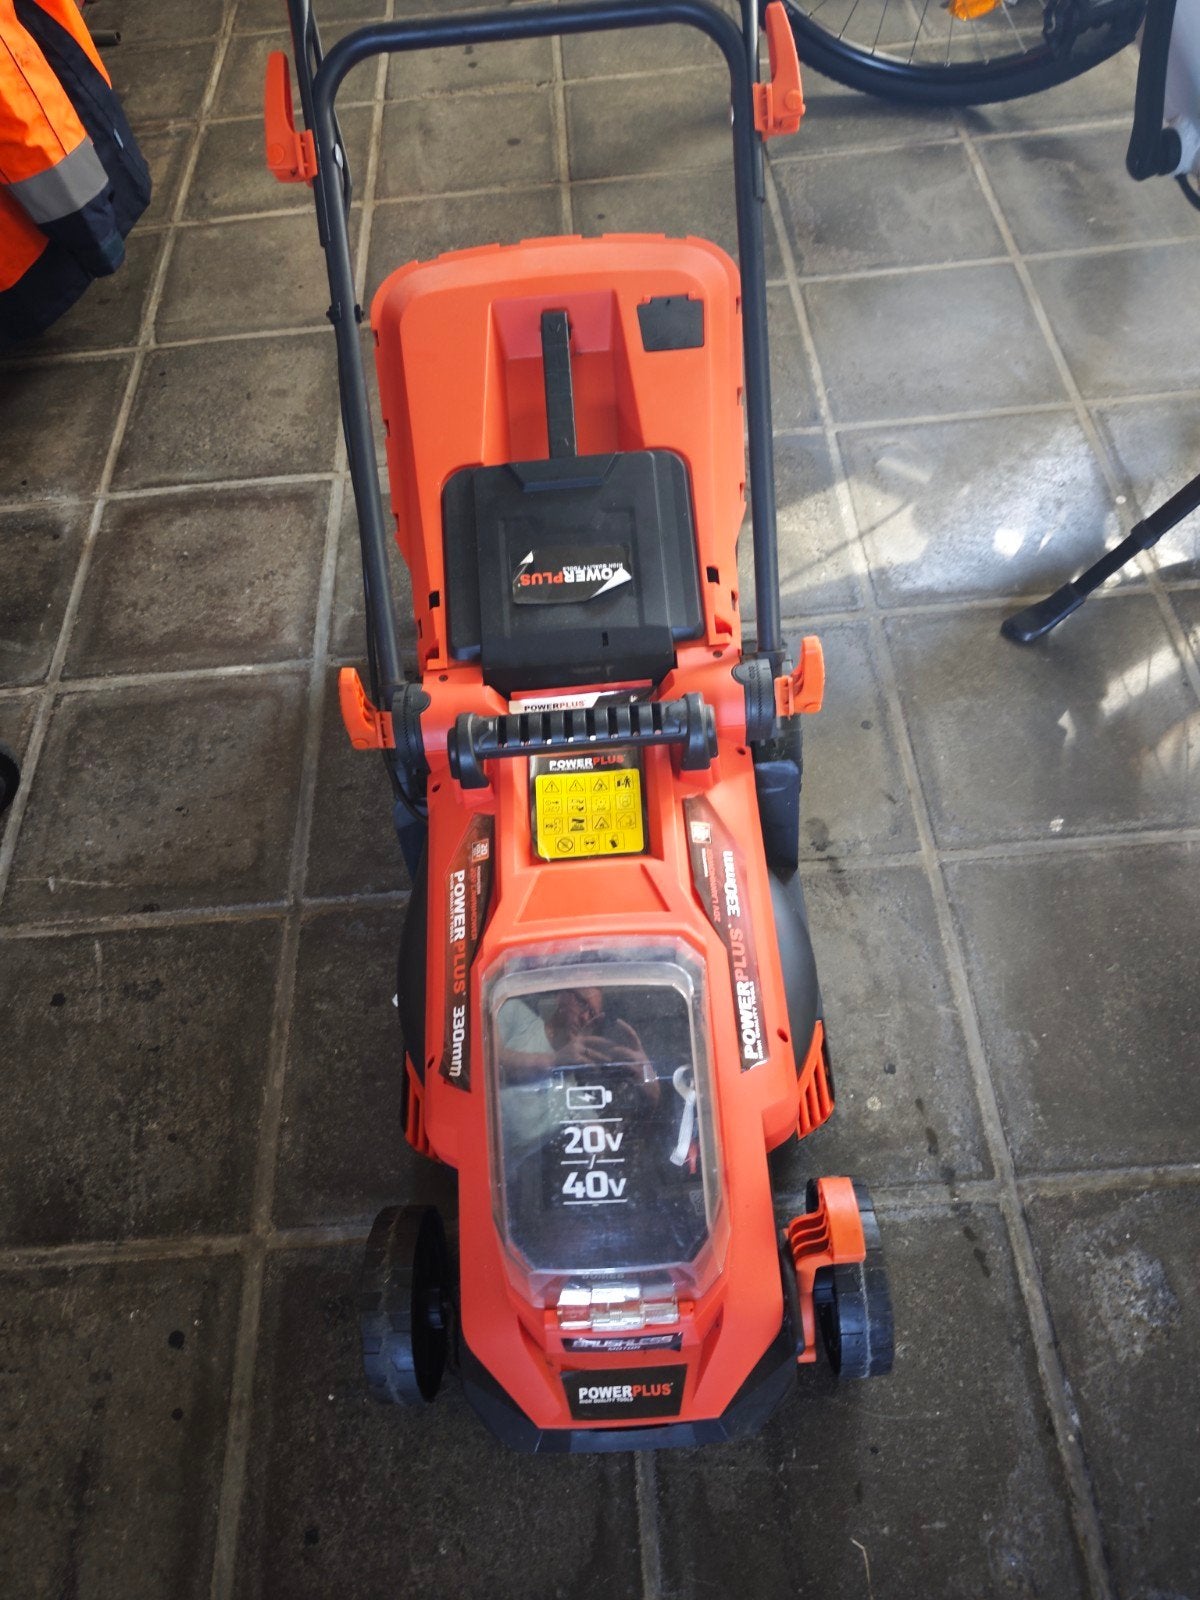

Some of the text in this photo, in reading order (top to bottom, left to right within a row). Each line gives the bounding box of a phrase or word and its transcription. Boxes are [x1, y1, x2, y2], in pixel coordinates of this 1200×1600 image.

[520, 568, 616, 587] OWERPLUS
[524, 701, 585, 712] POWERPLUS
[549, 754, 624, 769] POWERPLUS
[723, 850, 759, 1060] POWERPLUS 330mm
[449, 869, 465, 1077] POWERPLUS 330mm
[578, 1382, 671, 1400] POWERPLUS
